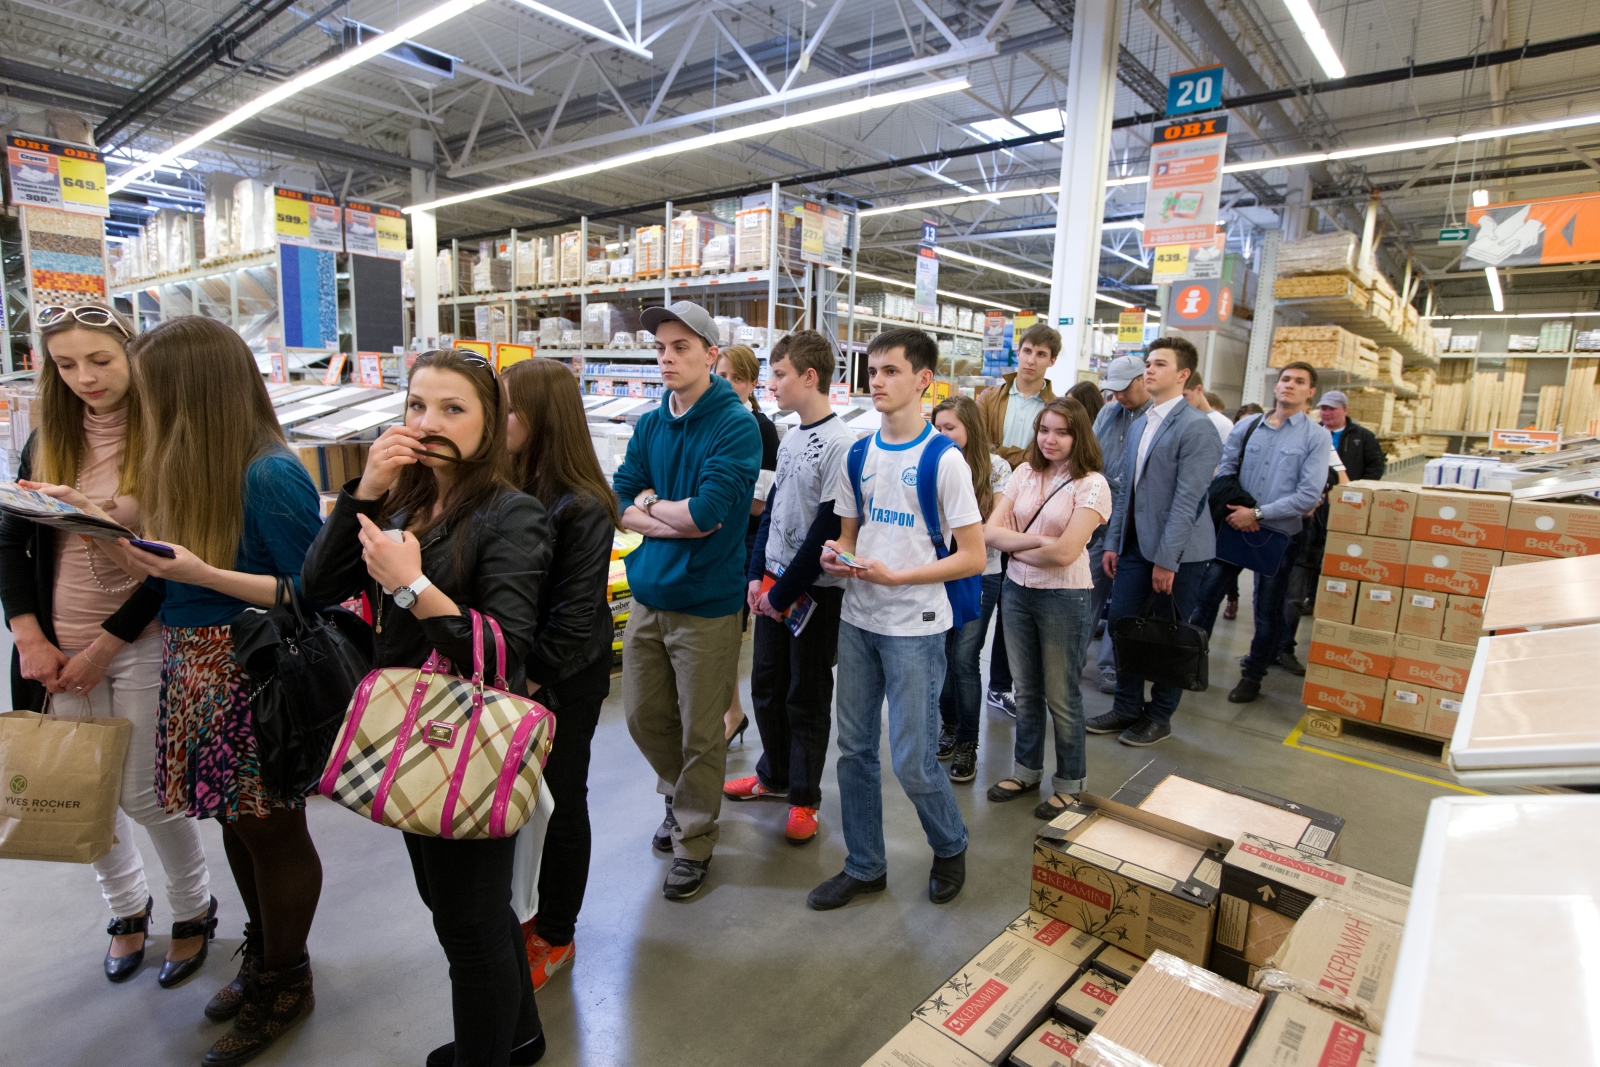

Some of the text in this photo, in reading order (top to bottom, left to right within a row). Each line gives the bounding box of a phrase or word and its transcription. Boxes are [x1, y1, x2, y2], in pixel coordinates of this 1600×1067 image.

[1176, 76, 1213, 107] 20
[1163, 119, 1217, 140] OBI
[13, 138, 98, 160] OBI OBI
[20, 153, 48, 163] Сервис
[278, 188, 335, 206] OBI OBI
[349, 202, 401, 218] OBI OBI
[805, 202, 841, 218] OBI OBI
[925, 226, 936, 242] 13
[920, 248, 936, 258] OBI
[742, 328, 753, 336] 552
[1314, 721, 1332, 732] EPAL
[5, 796, 81, 809] YVES ROCHER
[1257, 851, 1340, 883] КЕРАМИН
[1048, 871, 1105, 905] KERAMIN
[1323, 916, 1373, 987] КЕРАМИН
[956, 983, 1002, 1025] КЕРАМИН
